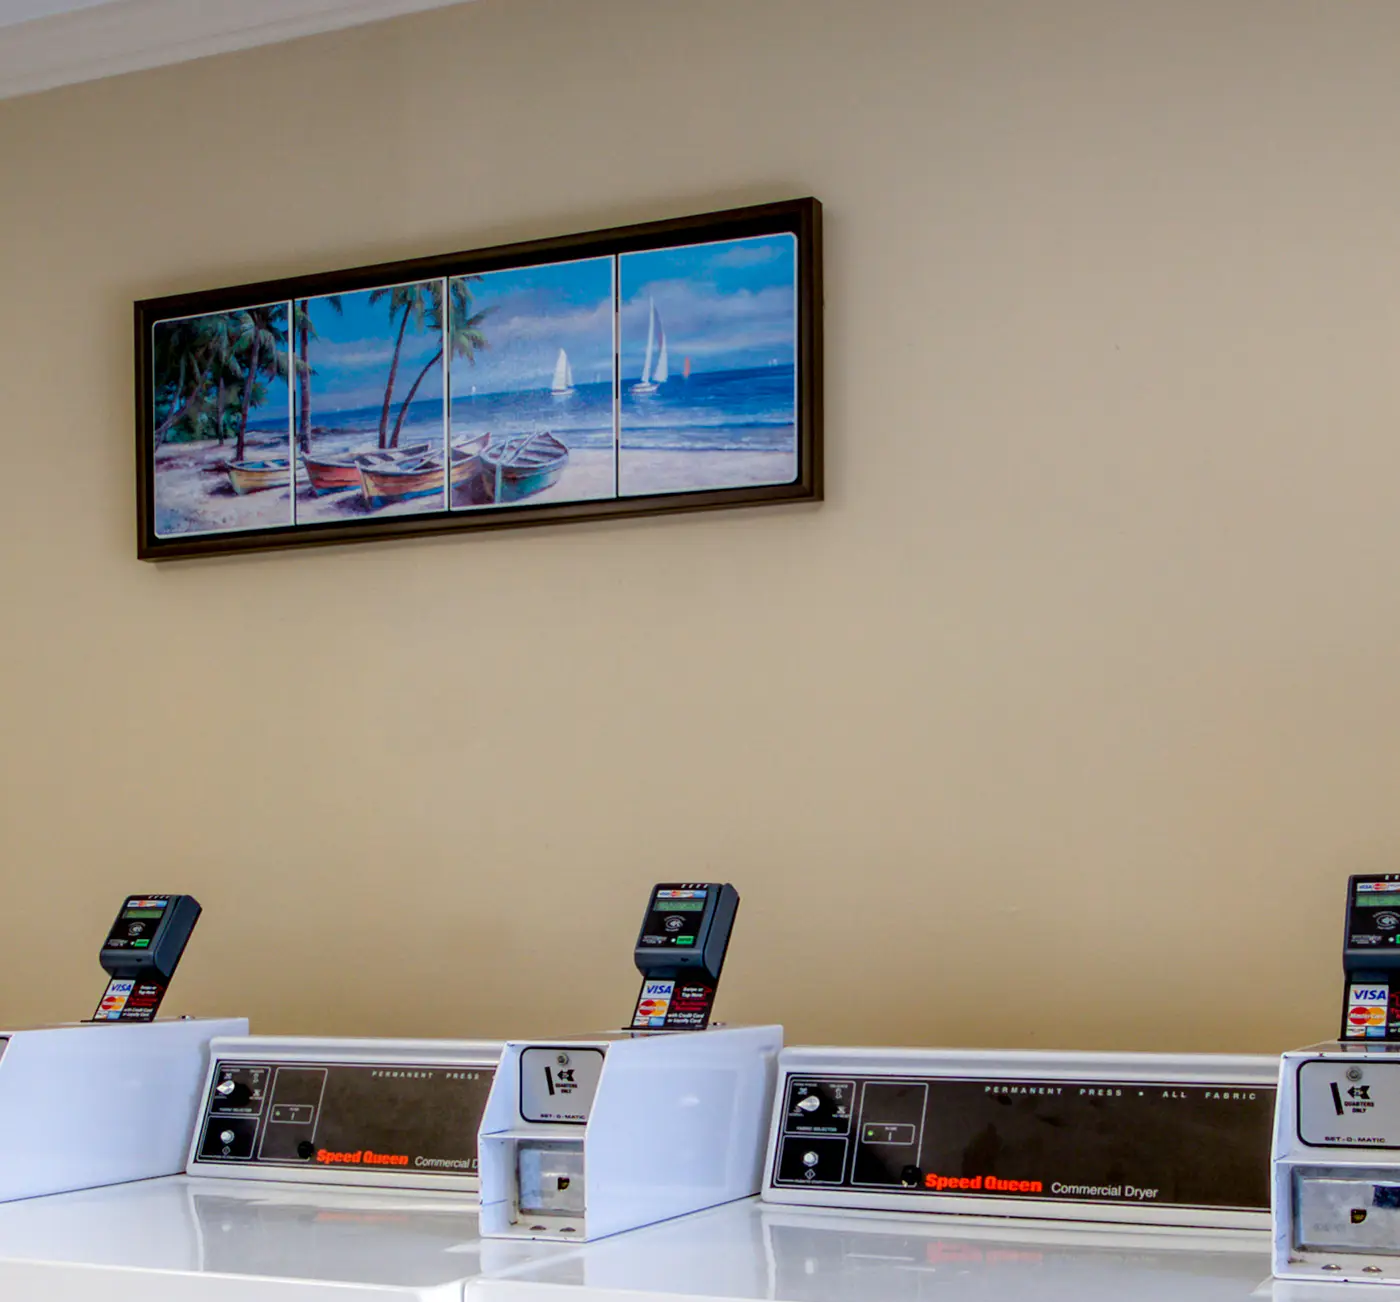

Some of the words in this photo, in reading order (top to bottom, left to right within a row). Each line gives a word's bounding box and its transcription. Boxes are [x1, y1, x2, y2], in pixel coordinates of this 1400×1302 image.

[647, 985, 672, 994] VISA
[1353, 989, 1386, 1000] VISA
[372, 1070, 434, 1079] PERMANENT
[984, 1086, 1064, 1096] PERMANENT
[1079, 1088, 1123, 1097] PRESS
[1162, 1090, 1188, 1099] ALL
[1205, 1092, 1256, 1100] FABRIC
[316, 1149, 361, 1165] Speed
[363, 1151, 409, 1166] Queen
[414, 1156, 470, 1169] Commercial
[925, 1173, 982, 1191] Speed
[984, 1175, 1043, 1192] Queen
[1051, 1182, 1122, 1197] Commercial
[1124, 1185, 1159, 1199] Dryer
